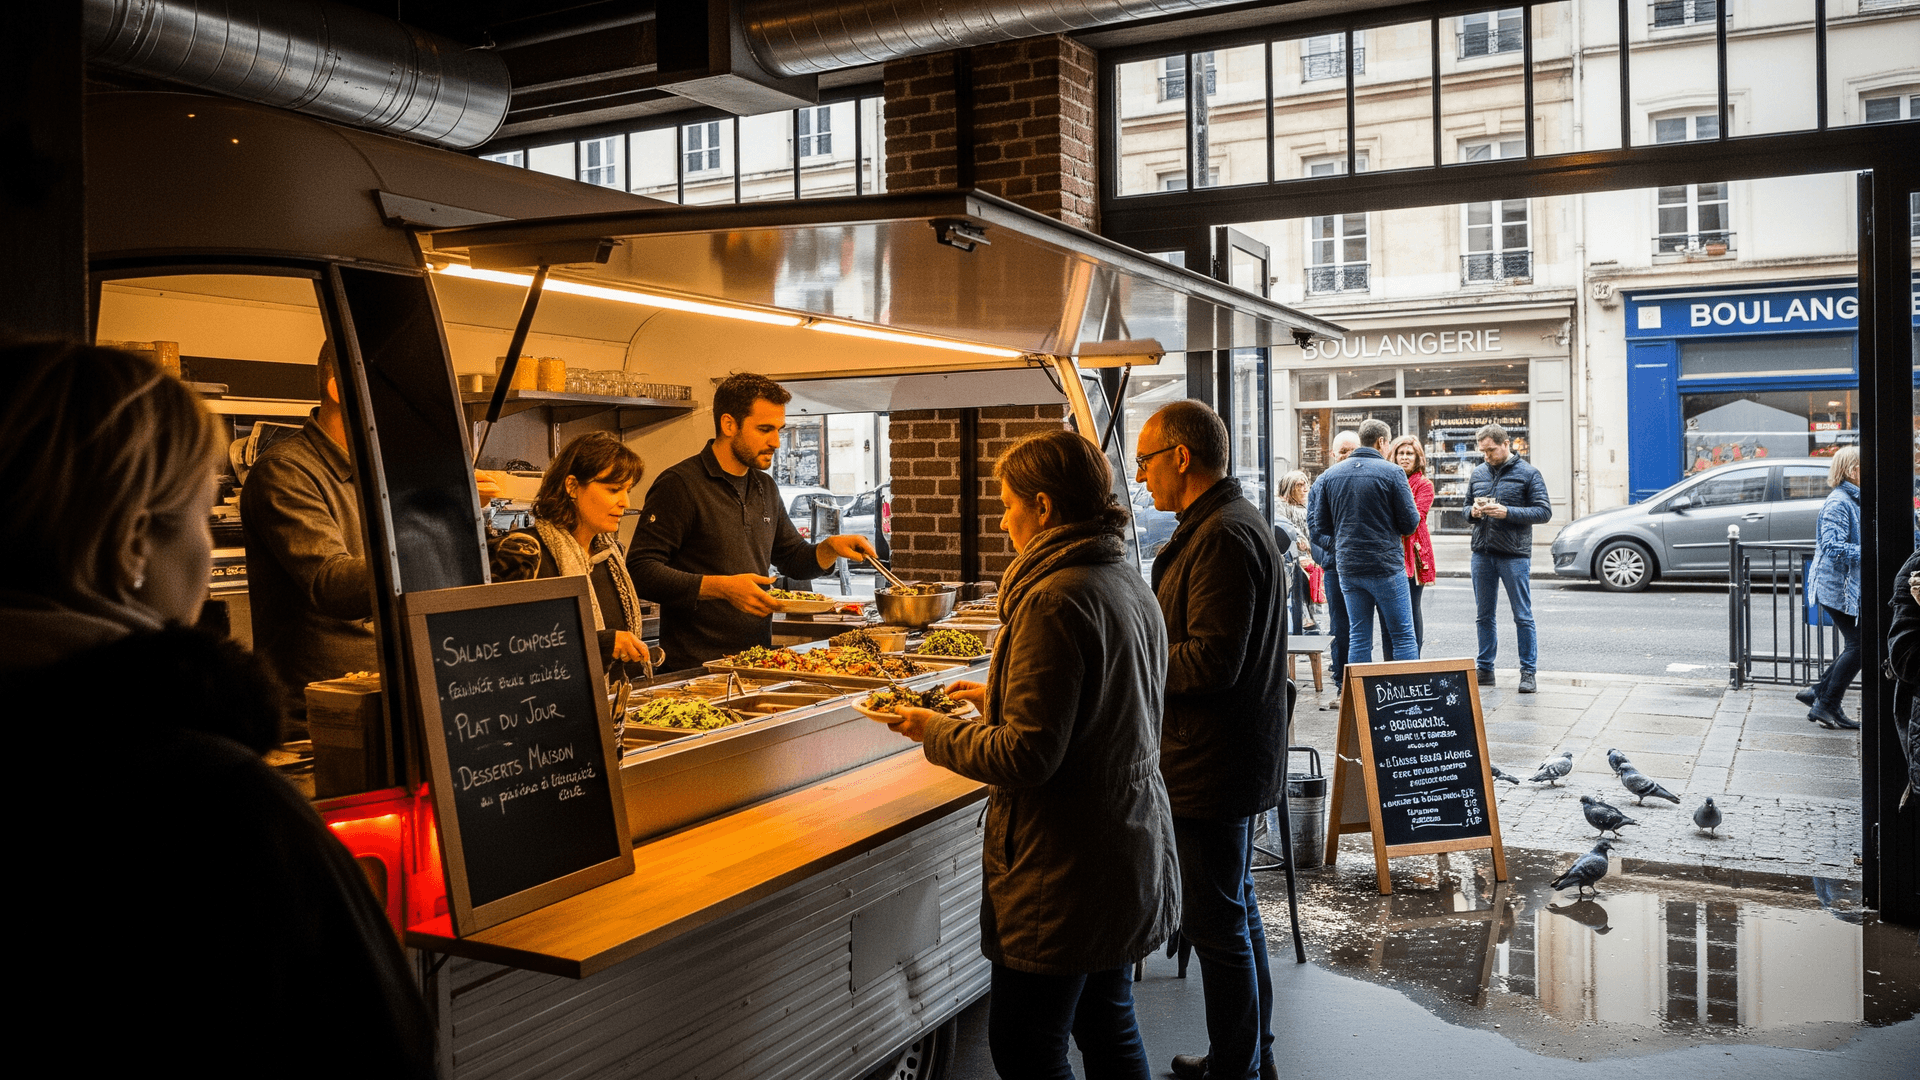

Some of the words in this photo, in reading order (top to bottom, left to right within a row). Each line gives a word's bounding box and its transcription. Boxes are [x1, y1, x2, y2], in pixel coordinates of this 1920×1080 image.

[443, 636, 502, 667] SALADE
[509, 622, 567, 654] COMPOSÉE
[455, 712, 491, 743] PLAT
[499, 713, 518, 731] DU
[520, 695, 566, 725] JOUR
[458, 759, 523, 791] DESSERTS
[528, 742, 574, 770] MAISON
